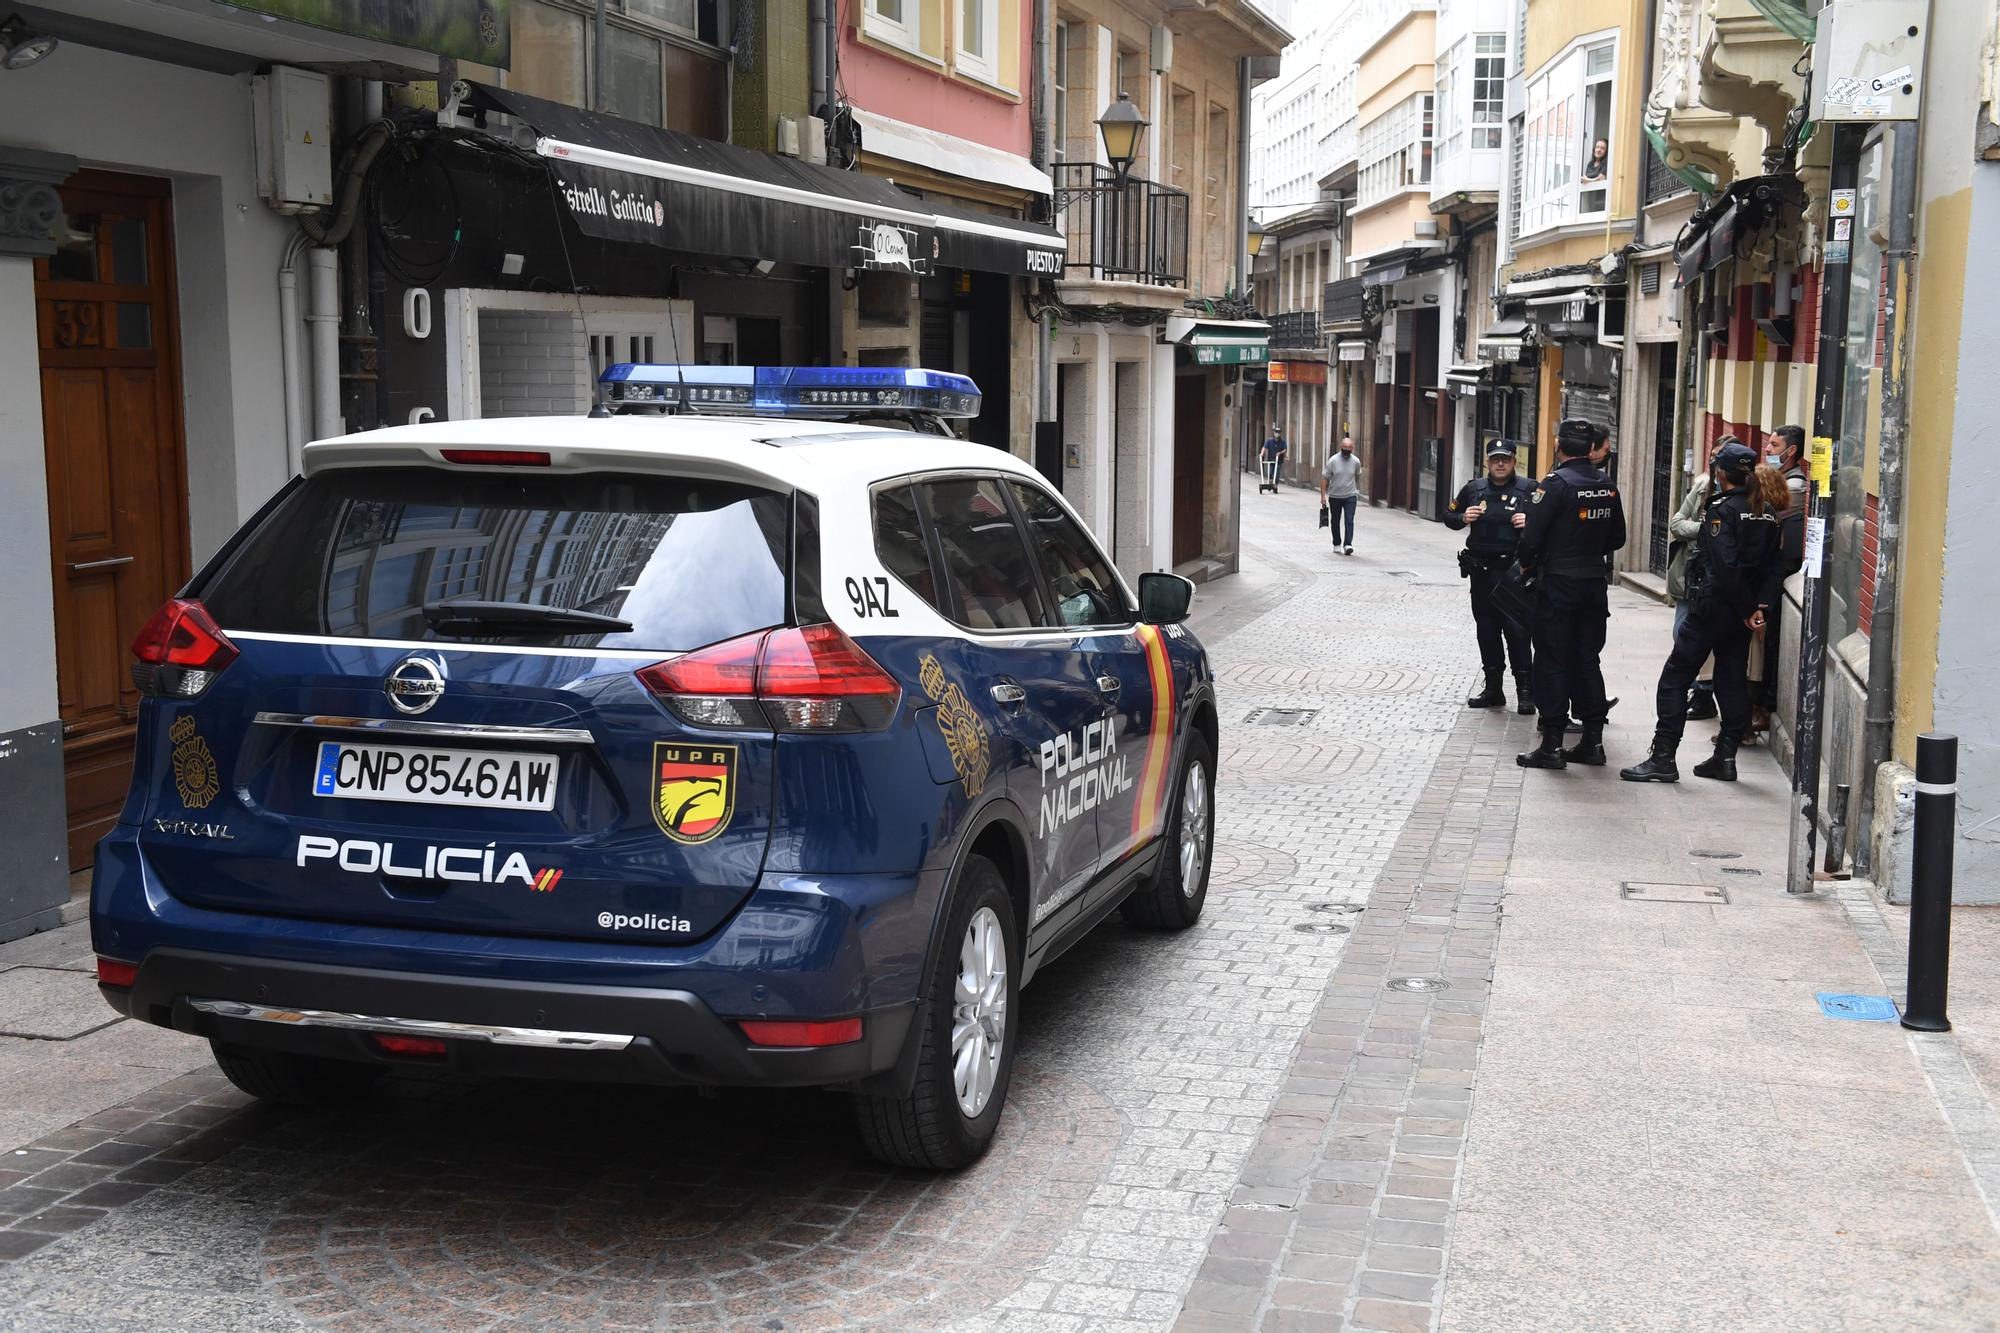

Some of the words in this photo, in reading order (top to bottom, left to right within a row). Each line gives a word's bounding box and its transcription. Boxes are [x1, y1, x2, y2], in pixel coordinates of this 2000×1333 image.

[610, 189, 654, 224] Galicia
[877, 233, 884, 253] O
[1026, 249, 1054, 273] PUESTO
[845, 576, 899, 618] 9AZ
[390, 679, 437, 692] NISSAN
[1040, 710, 1116, 788] POLICÍA
[322, 775, 331, 786] E
[1039, 754, 1133, 839] NACIONAL
[152, 818, 235, 840] X-TRAIL
[297, 835, 536, 886] POLICÍA
[597, 911, 691, 933] @policia
